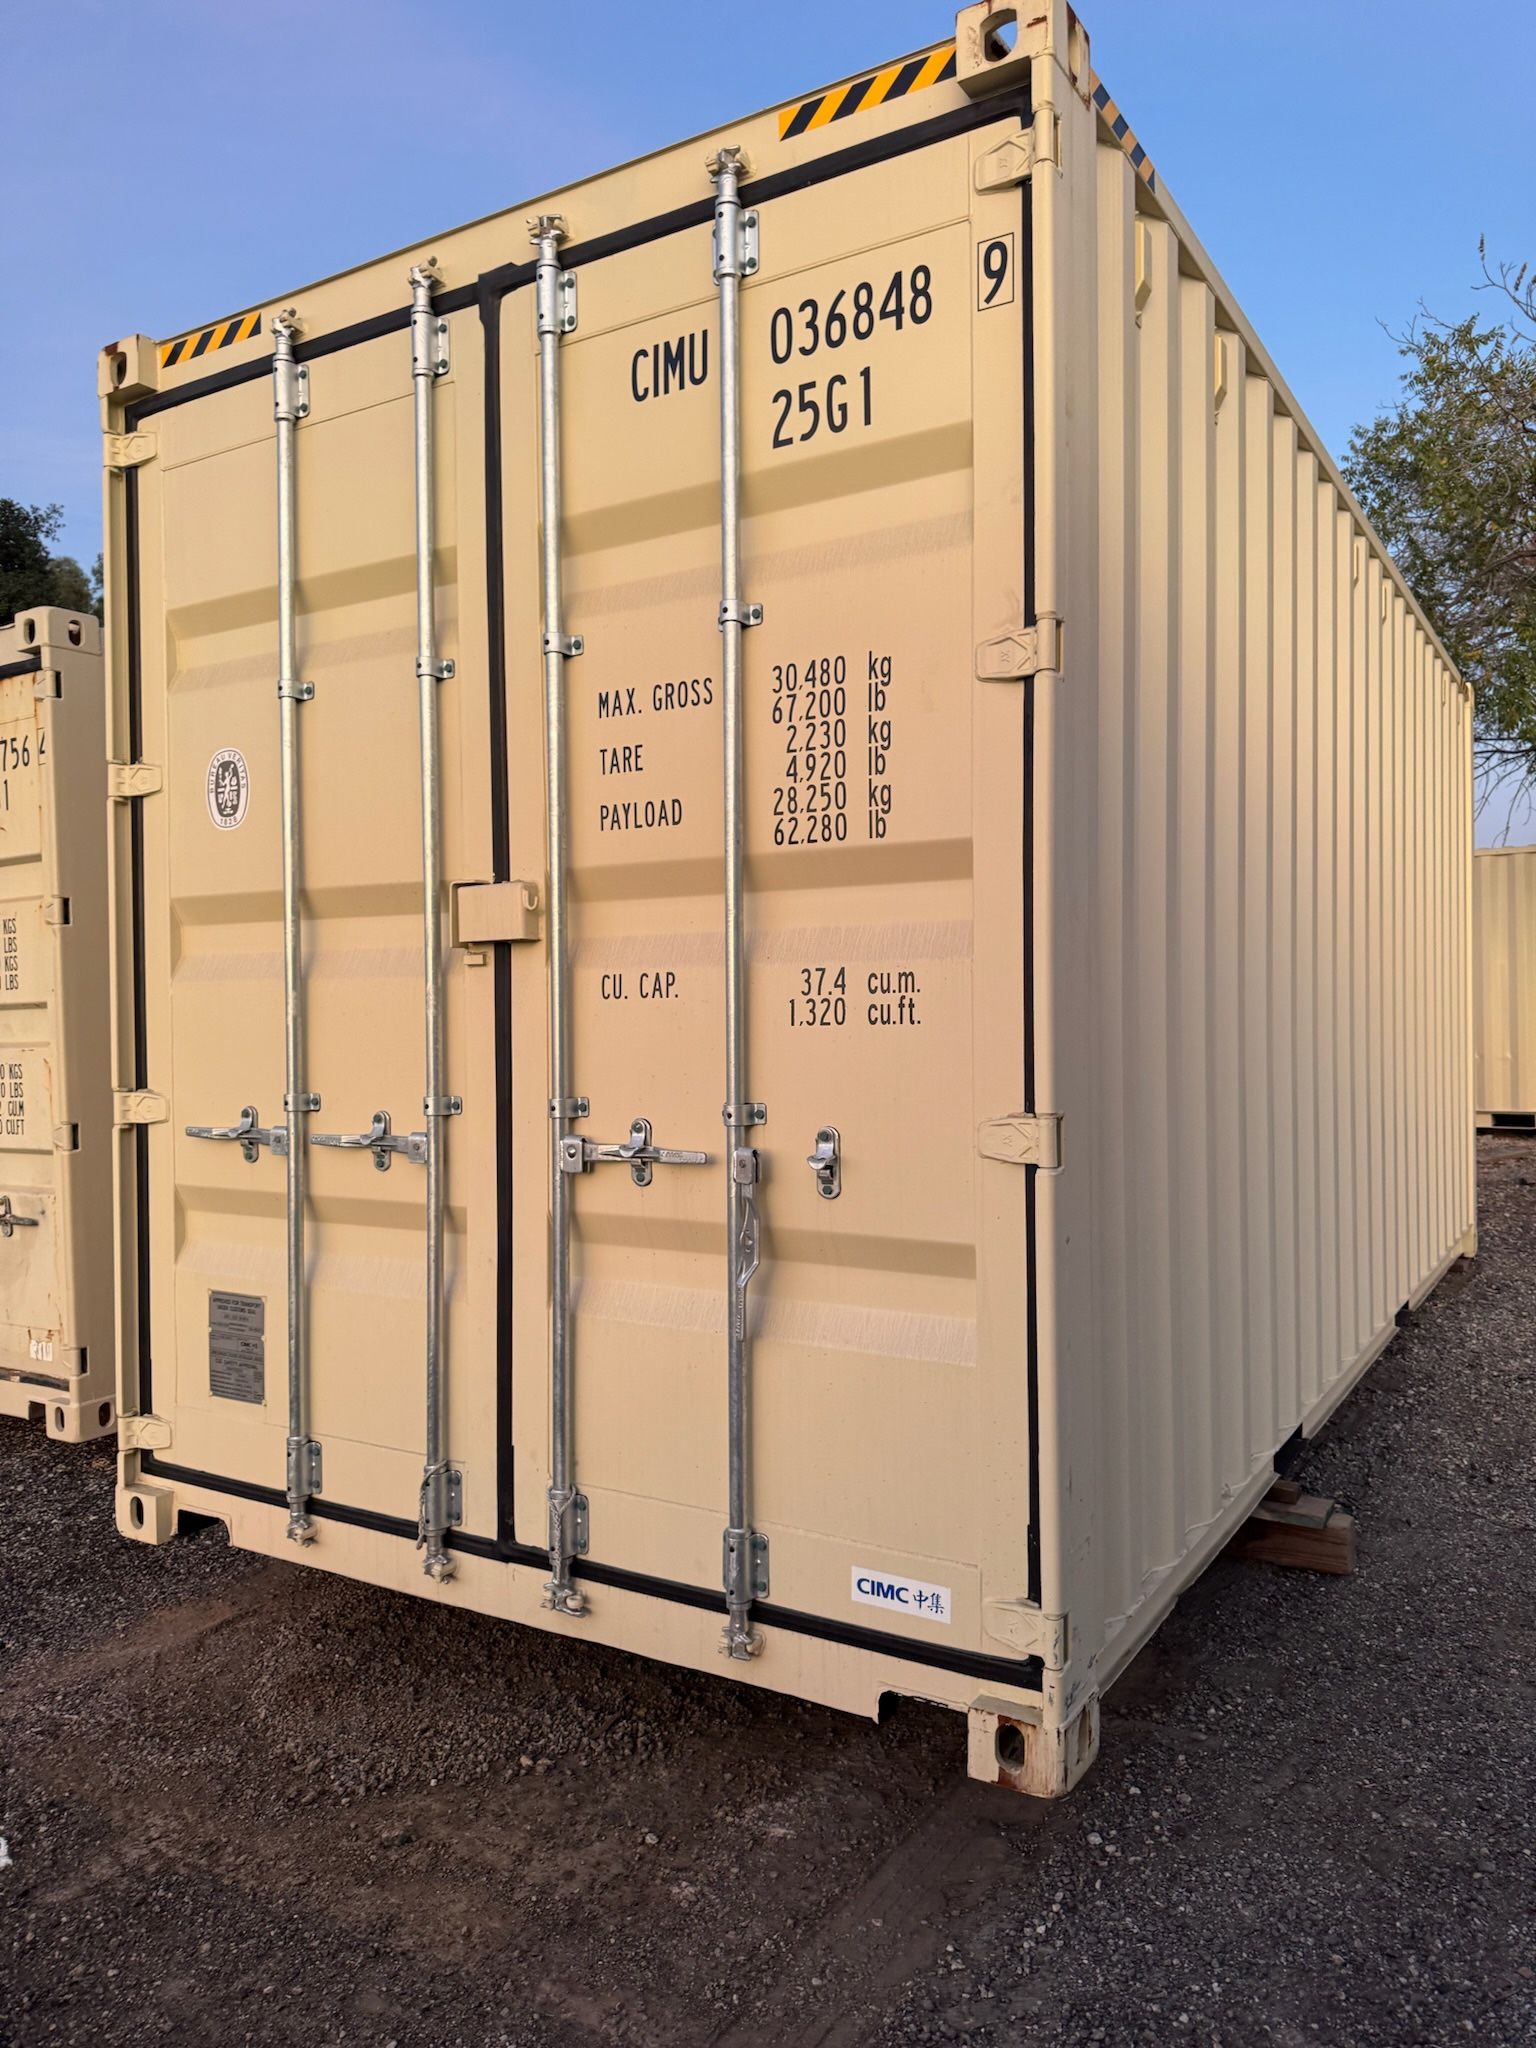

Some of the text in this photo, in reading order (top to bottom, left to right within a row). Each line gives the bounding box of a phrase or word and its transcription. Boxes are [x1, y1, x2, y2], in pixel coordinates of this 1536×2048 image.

[631, 241, 1008, 403] CIMU 036848 9
[772, 366, 871, 449] 25G1
[598, 651, 892, 719] MAX. GROSS 30,480 kg
[772, 682, 886, 724] 67,200 lb
[600, 715, 892, 775] TARE 2,230 kg
[786, 746, 886, 783] 4,920 lb
[600, 779, 892, 831] PAYLOAD 28,250 kg
[774, 809, 886, 846] 62,280 lb
[601, 966, 921, 1000] CU. CAP. 37.4 cu.m.
[789, 995, 921, 1027] 1,320 cu.ft.
[857, 1578, 945, 1614] CIMC 中集
